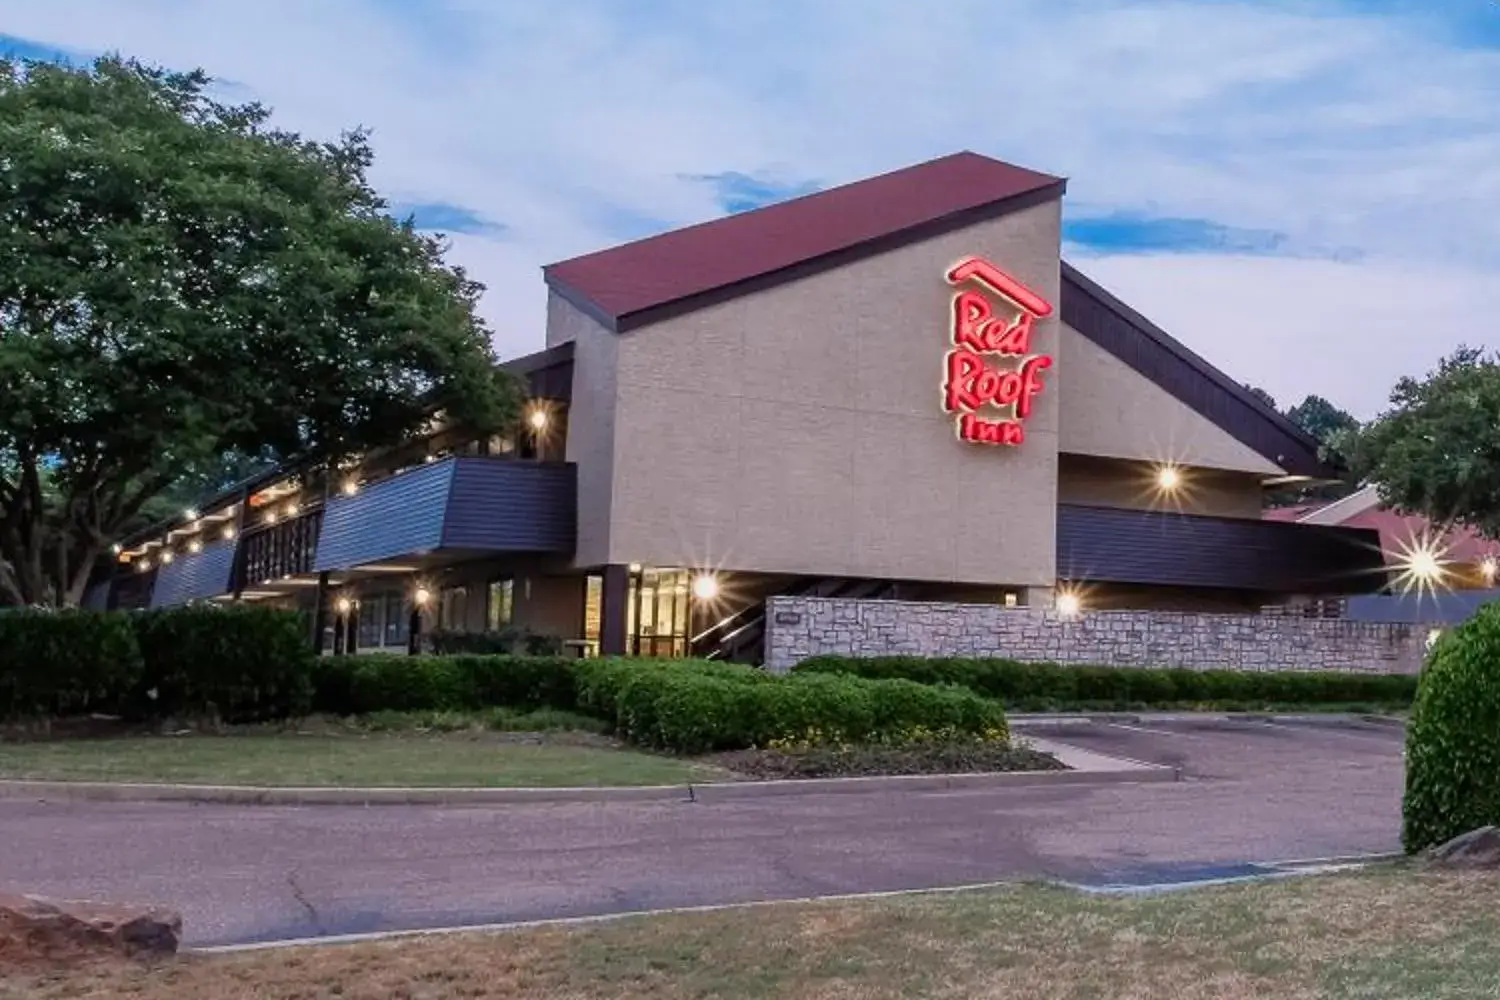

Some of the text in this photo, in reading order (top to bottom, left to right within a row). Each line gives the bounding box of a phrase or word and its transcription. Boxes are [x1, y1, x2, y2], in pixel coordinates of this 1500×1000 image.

[953, 289, 1033, 355] Red
[943, 349, 1052, 418] Roof
[958, 413, 1025, 445] Inn
